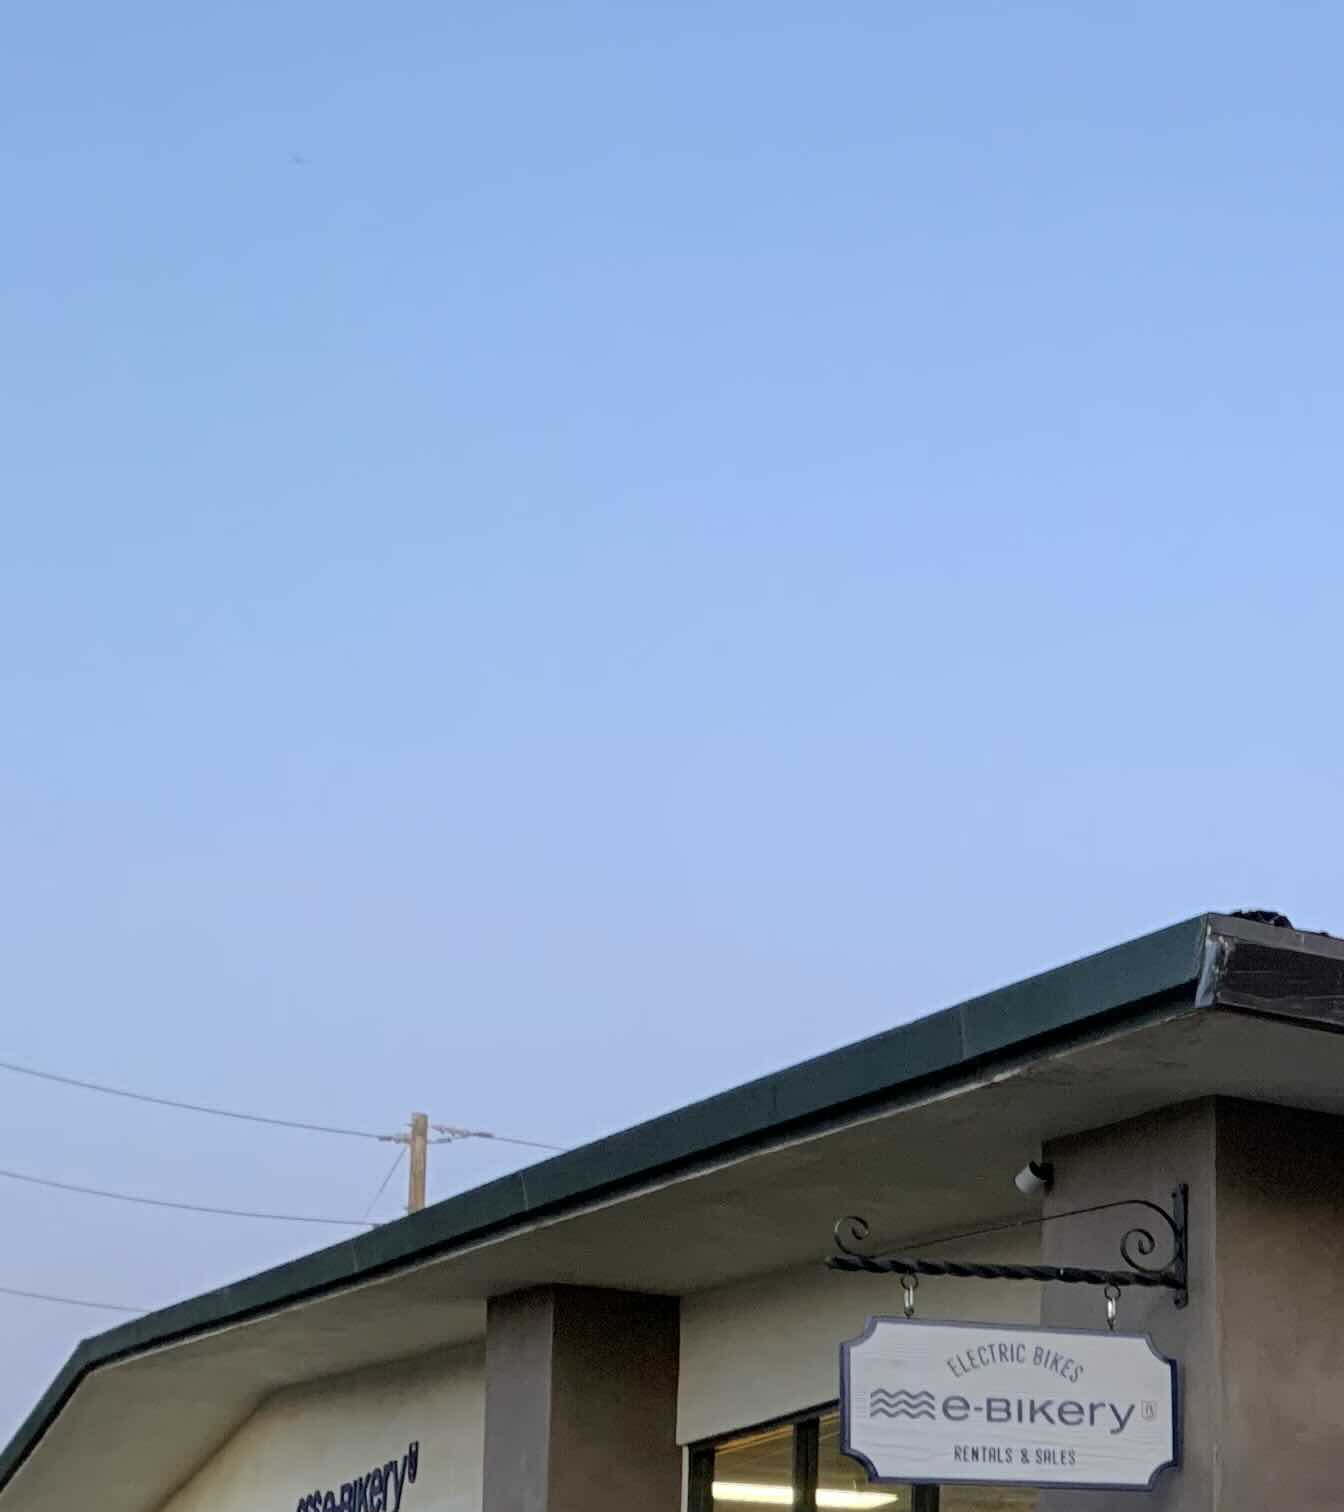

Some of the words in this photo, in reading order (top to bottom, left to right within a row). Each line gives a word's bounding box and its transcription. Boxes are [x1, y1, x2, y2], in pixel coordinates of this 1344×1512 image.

[946, 1341, 1025, 1379] ELECTRIC
[1032, 1345, 1084, 1383] BIKES
[954, 1445, 1013, 1465] RENTALS
[1020, 1447, 1030, 1465] &
[1035, 1448, 1077, 1466] SALES
